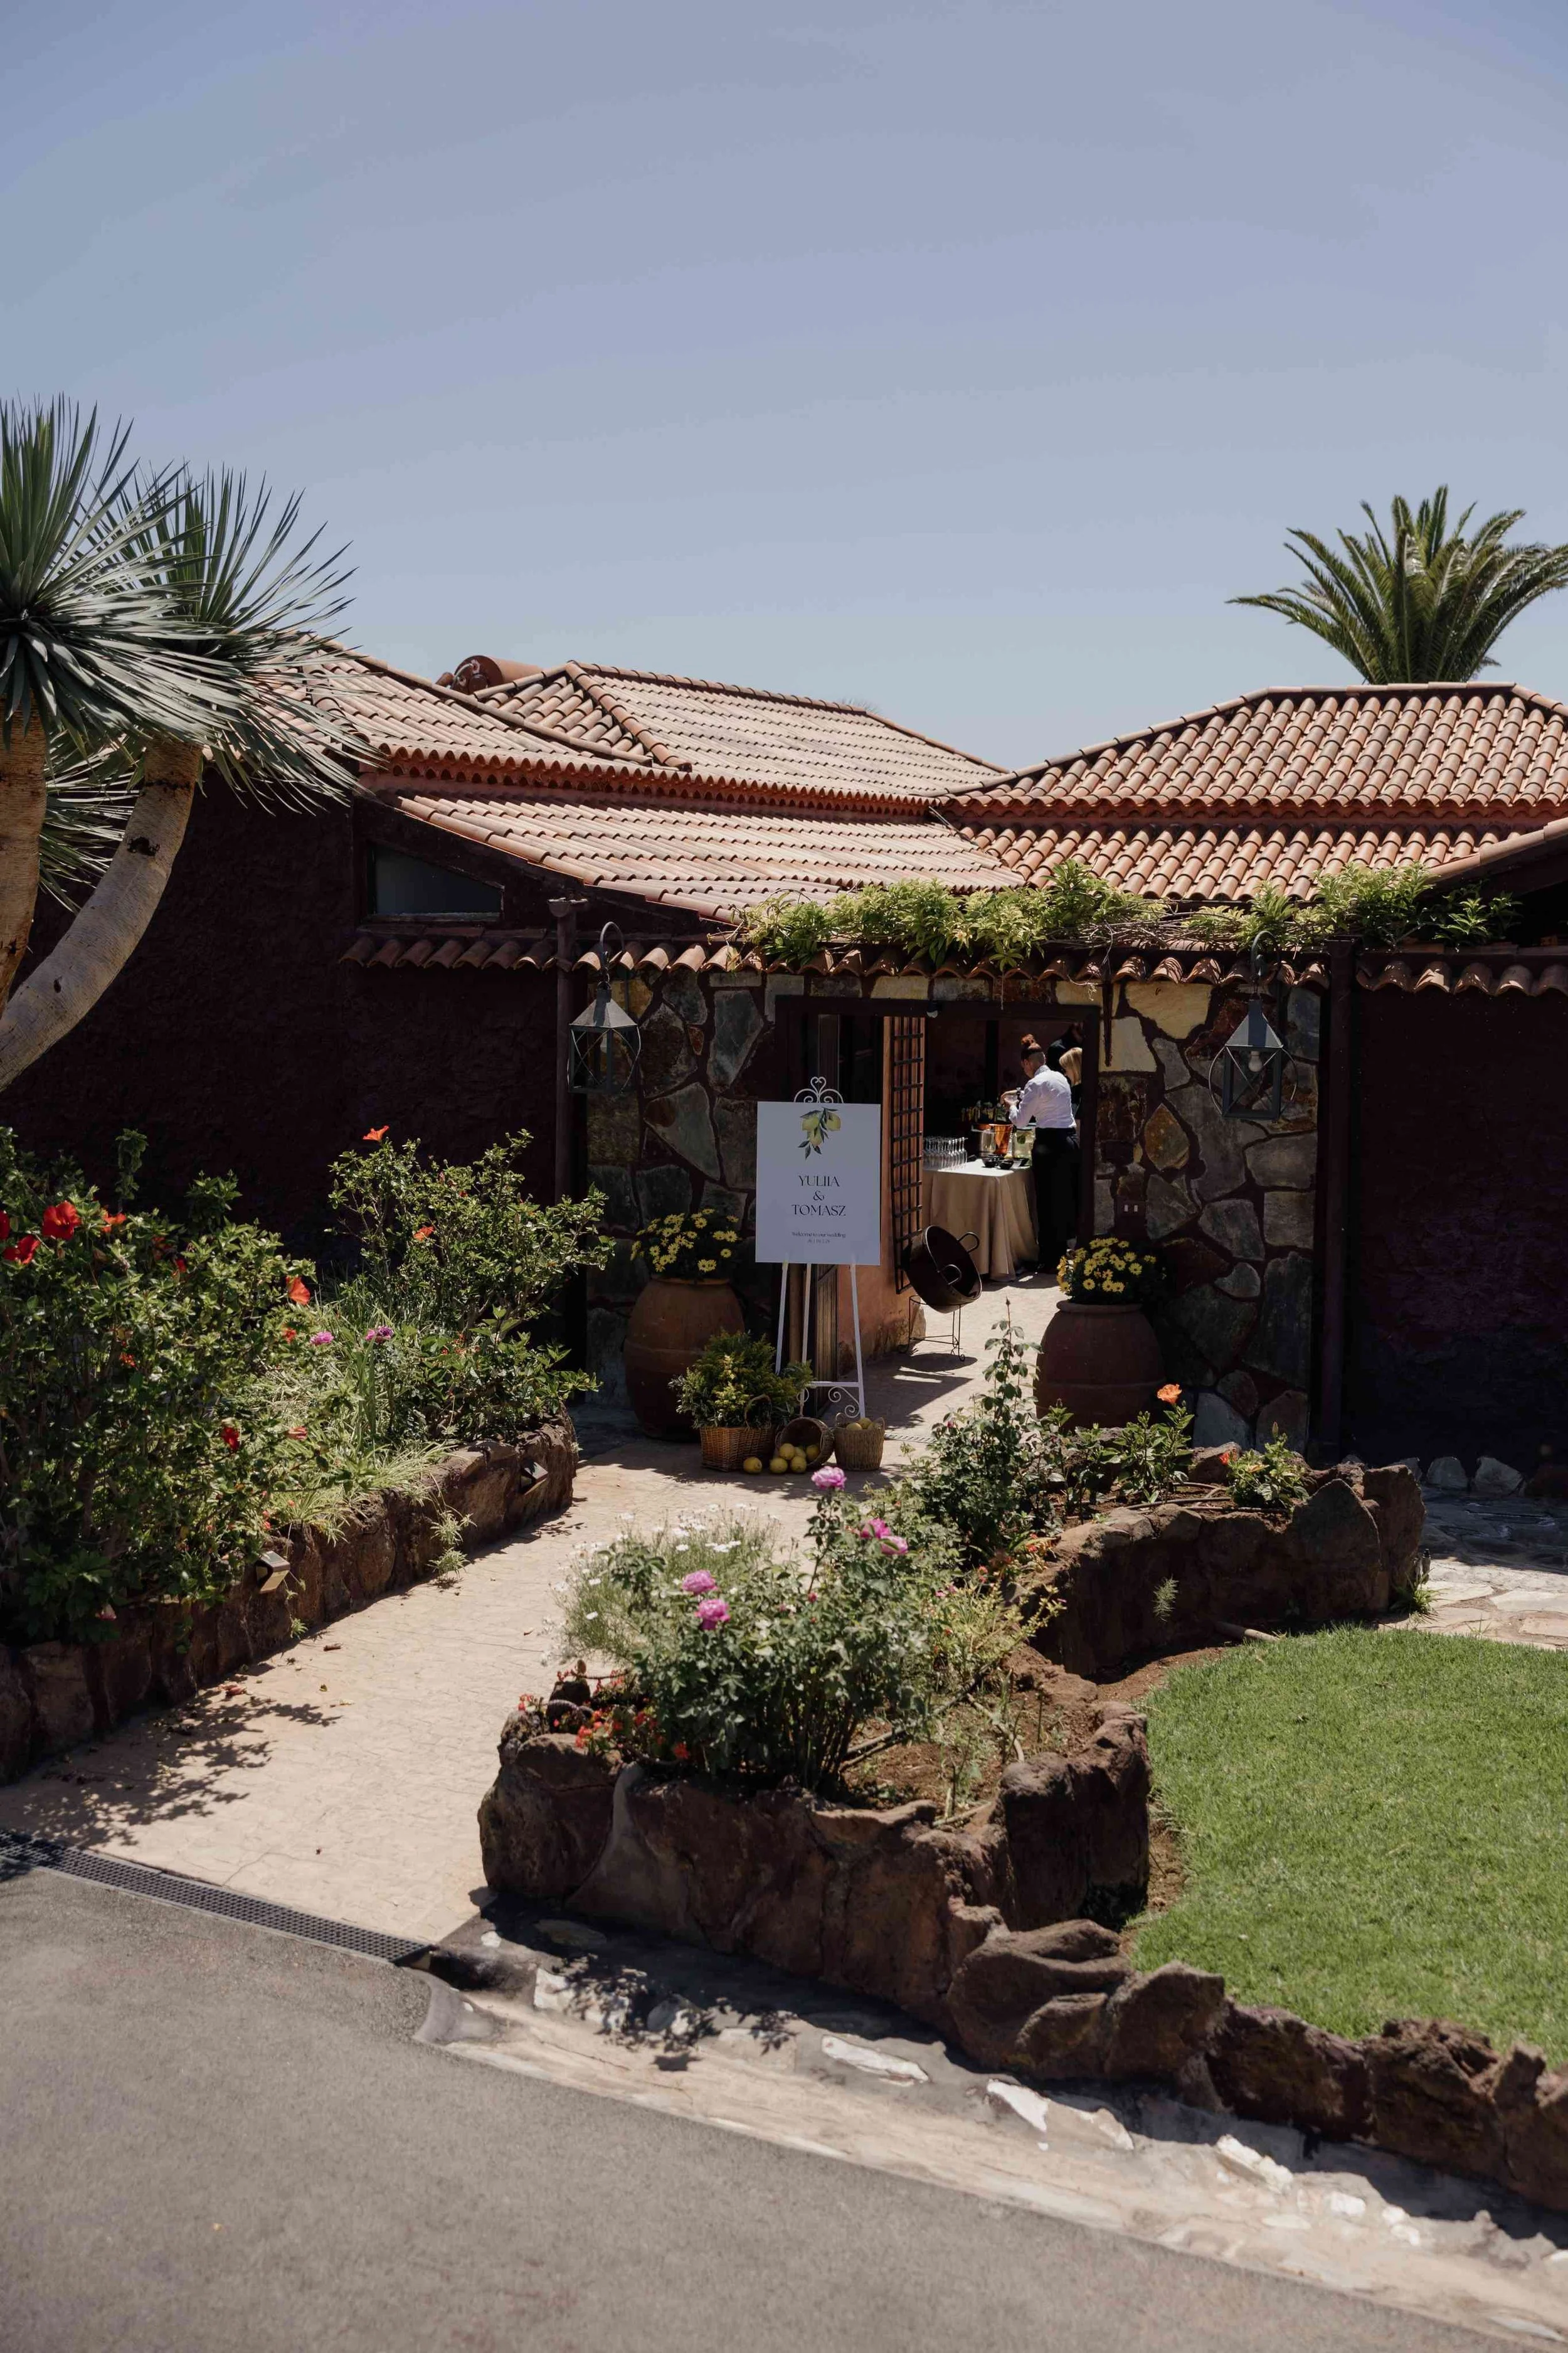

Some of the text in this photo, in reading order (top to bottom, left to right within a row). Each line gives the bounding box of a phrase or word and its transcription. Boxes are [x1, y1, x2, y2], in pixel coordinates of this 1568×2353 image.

[798, 1176, 840, 1187] YULIIA
[813, 1191, 825, 1201] &
[792, 1204, 846, 1216] TOMASZ
